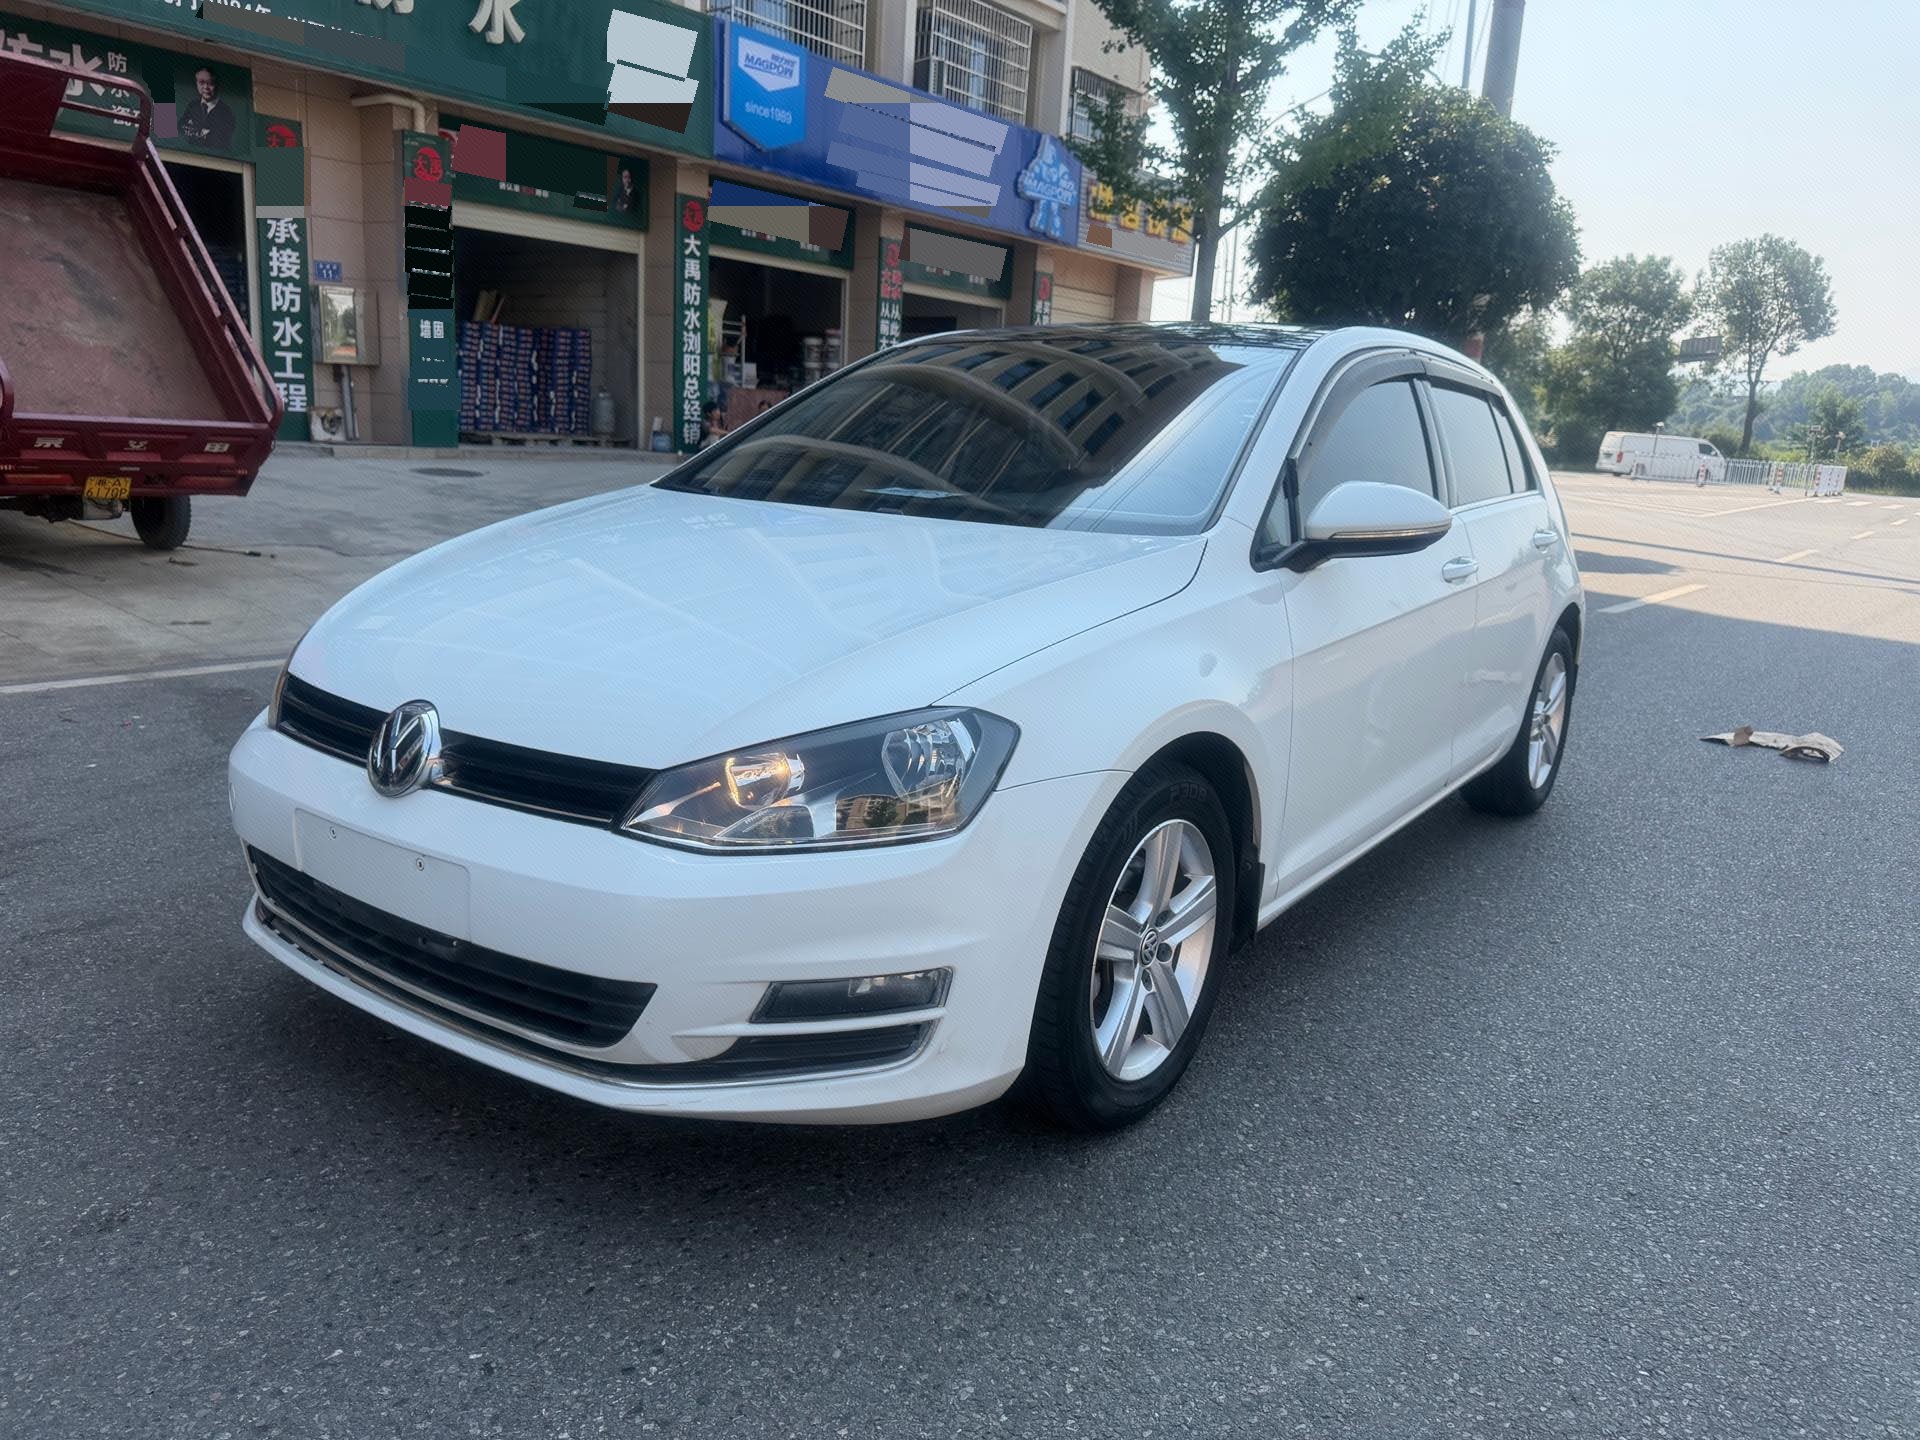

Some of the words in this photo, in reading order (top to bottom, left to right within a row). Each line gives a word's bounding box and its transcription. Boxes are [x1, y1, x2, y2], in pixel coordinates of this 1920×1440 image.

[267, 217, 307, 413] 承接防水工程
[682, 234, 702, 445] 大禹防水浏阳总经销
